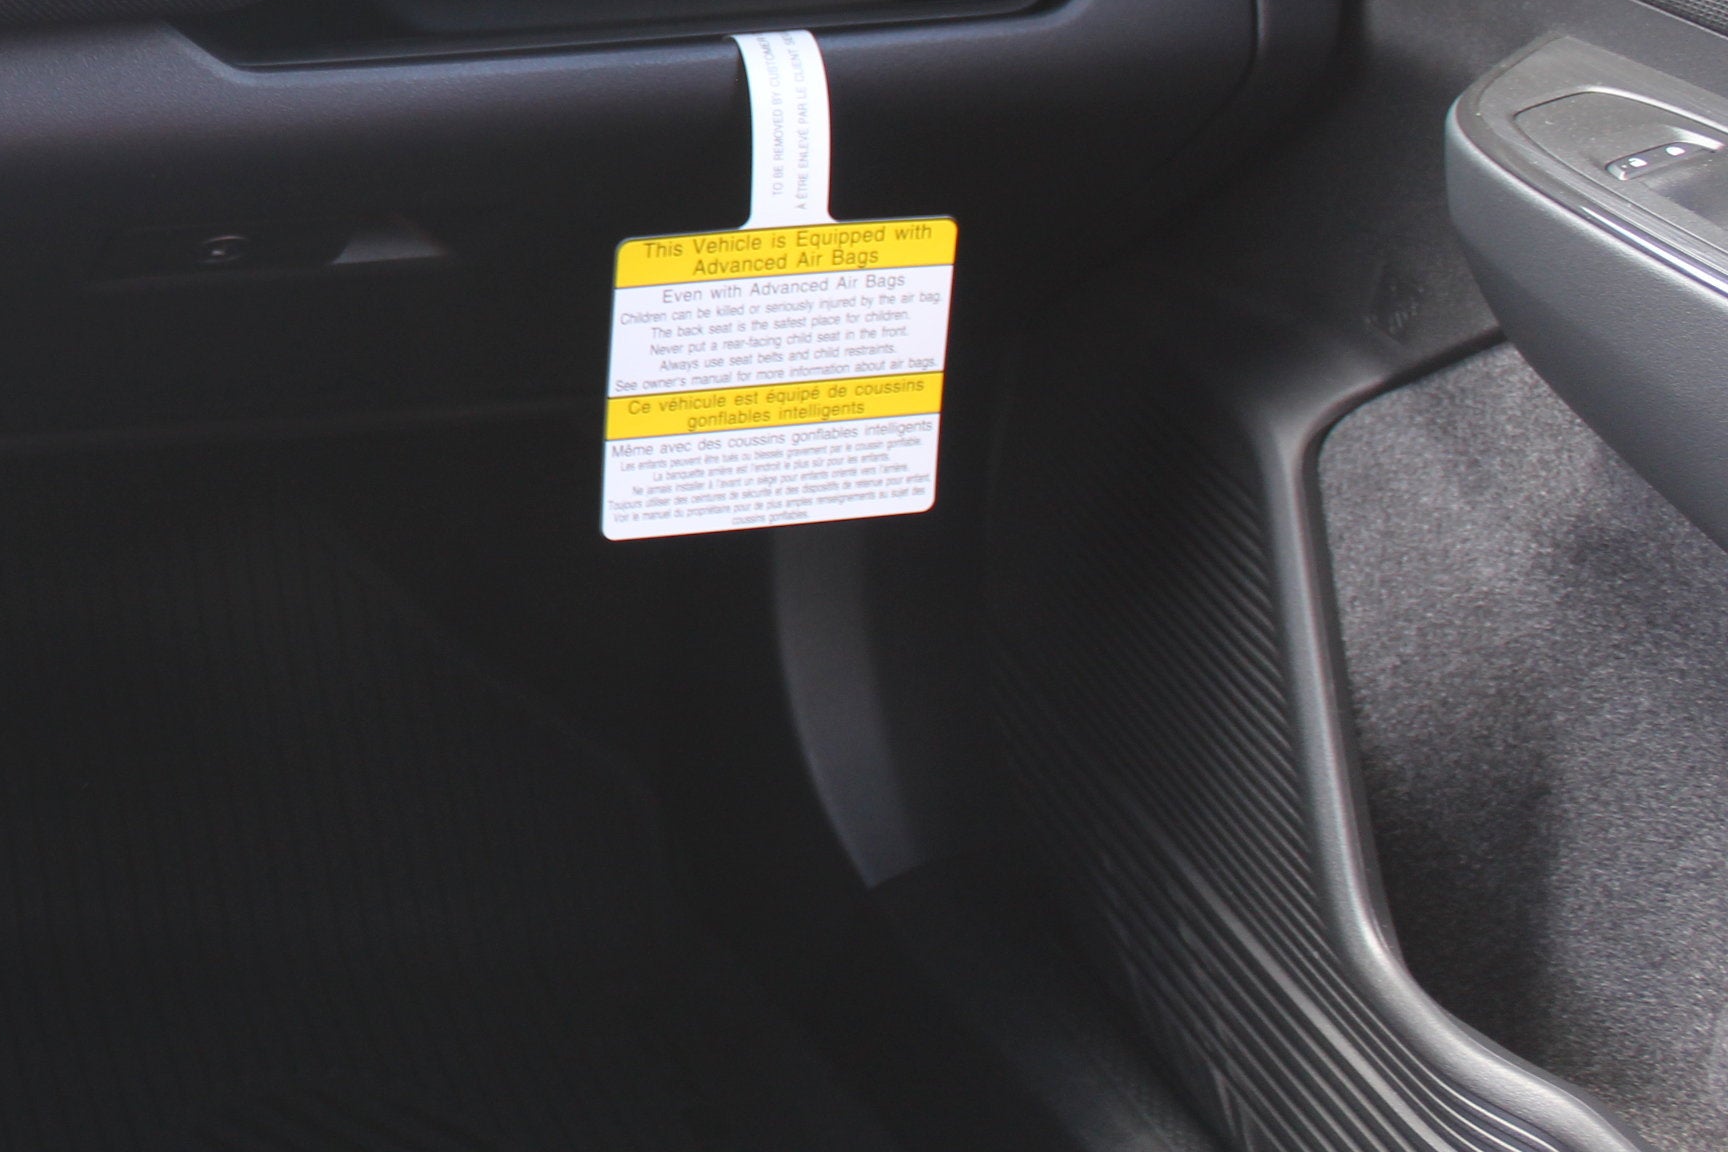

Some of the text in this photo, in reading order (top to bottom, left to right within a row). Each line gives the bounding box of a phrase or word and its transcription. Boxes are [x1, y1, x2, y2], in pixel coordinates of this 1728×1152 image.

[643, 223, 933, 258] This Vehicle is Equipped with
[692, 249, 879, 275] Advanced Air Bags
[662, 274, 905, 303] Even with Advanced Air Bags
[627, 379, 924, 414] Ce véhicule est équipé de coussins
[687, 400, 867, 431] gonflables intelligents
